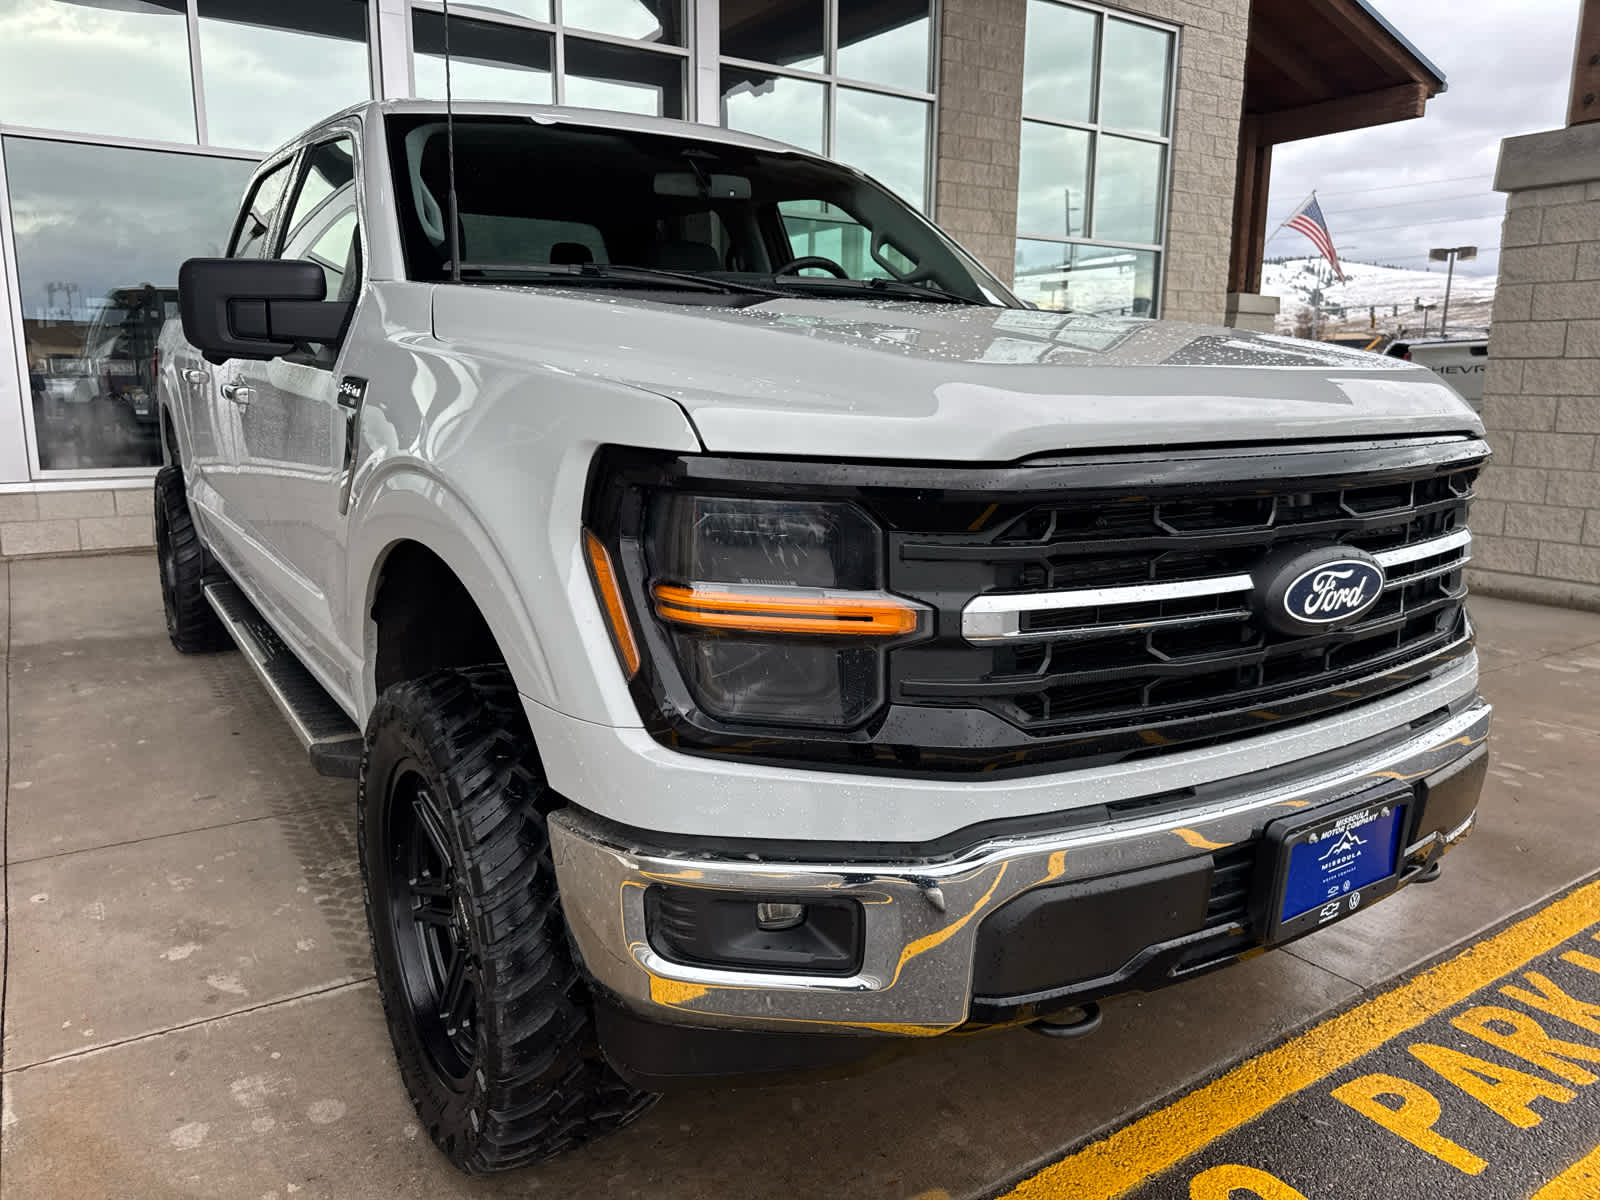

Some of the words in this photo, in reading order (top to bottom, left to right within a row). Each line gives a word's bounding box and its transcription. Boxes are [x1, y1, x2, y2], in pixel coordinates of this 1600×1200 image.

[1429, 364, 1486, 375] HEVR
[1303, 569, 1368, 615] Ford
[1320, 825, 1346, 840] MOTOR
[1346, 812, 1379, 830] COMPANY
[1335, 809, 1369, 828] MISSOULA
[1321, 850, 1362, 870] MISSOULA
[1329, 930, 1600, 1176] PARK
